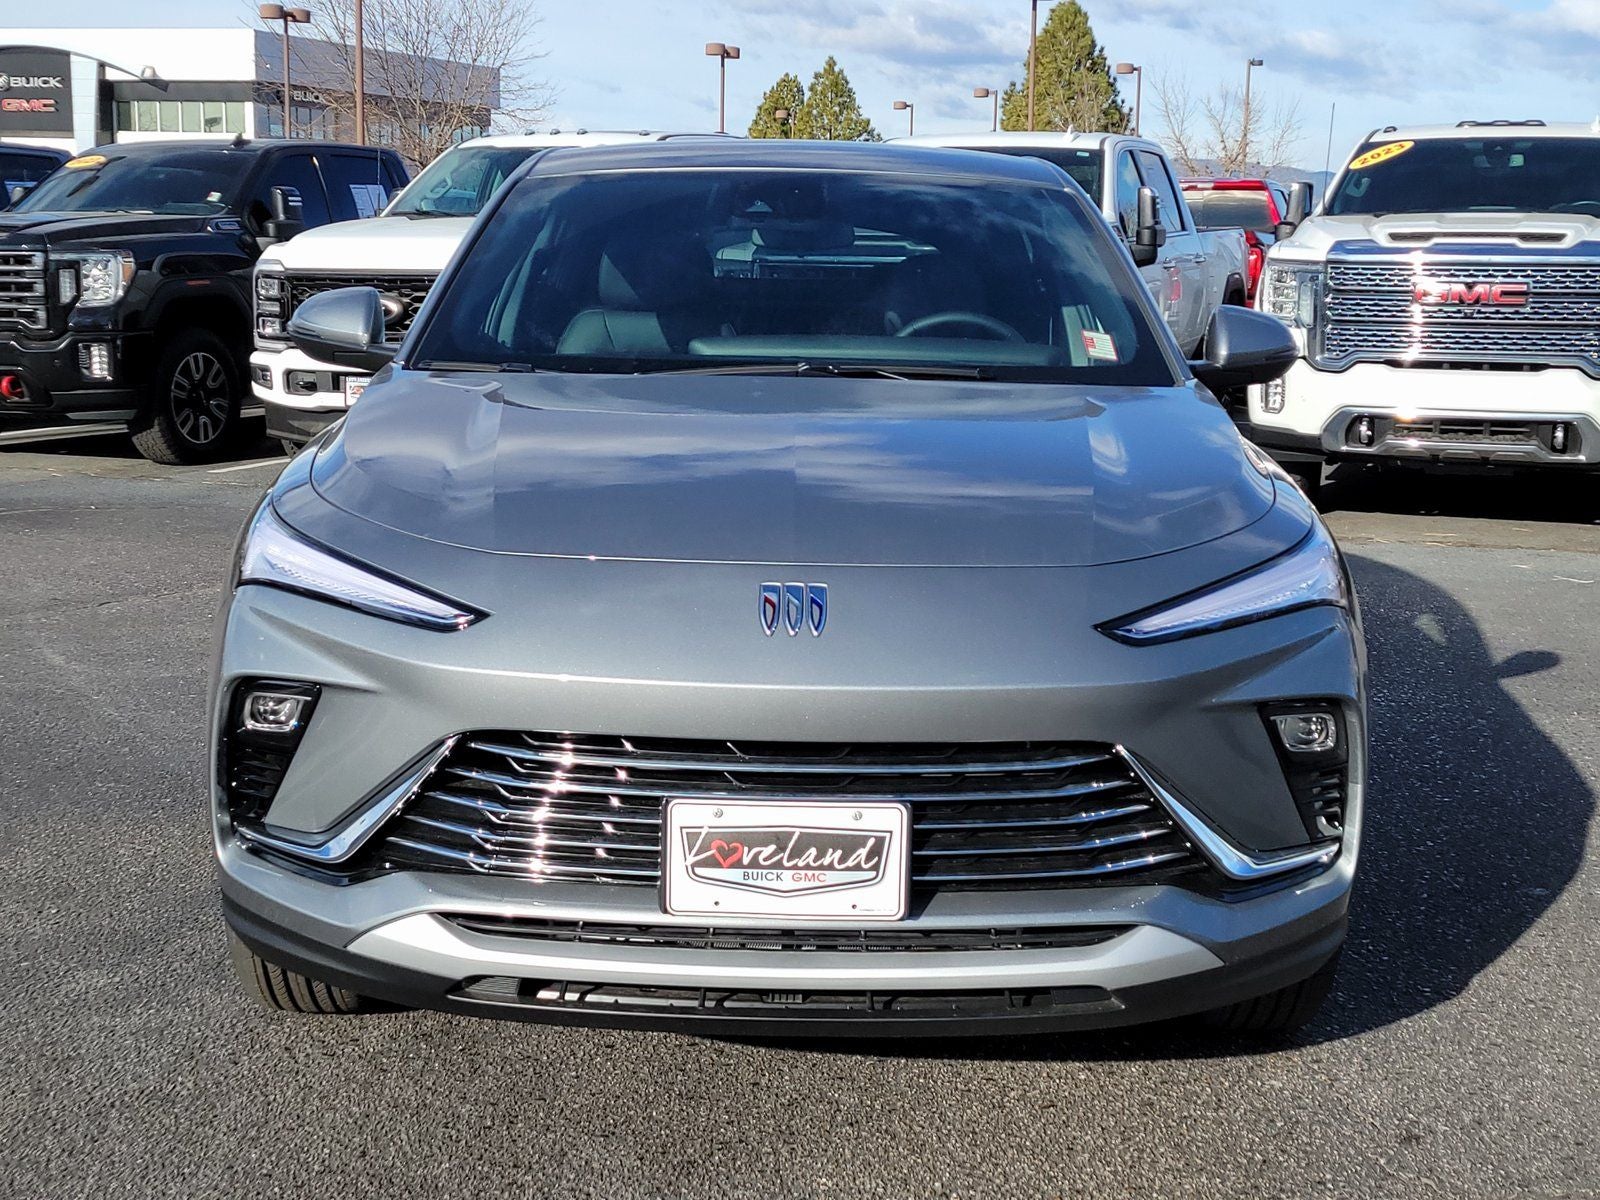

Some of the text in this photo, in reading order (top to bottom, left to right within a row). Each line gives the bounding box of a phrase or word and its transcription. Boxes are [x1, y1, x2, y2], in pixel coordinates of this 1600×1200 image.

[9, 76, 64, 88] BUICK
[1, 98, 57, 112] GMC
[1358, 143, 1405, 165] 2023
[1414, 283, 1528, 305] GMC
[742, 871, 827, 883] BUICK GMC
